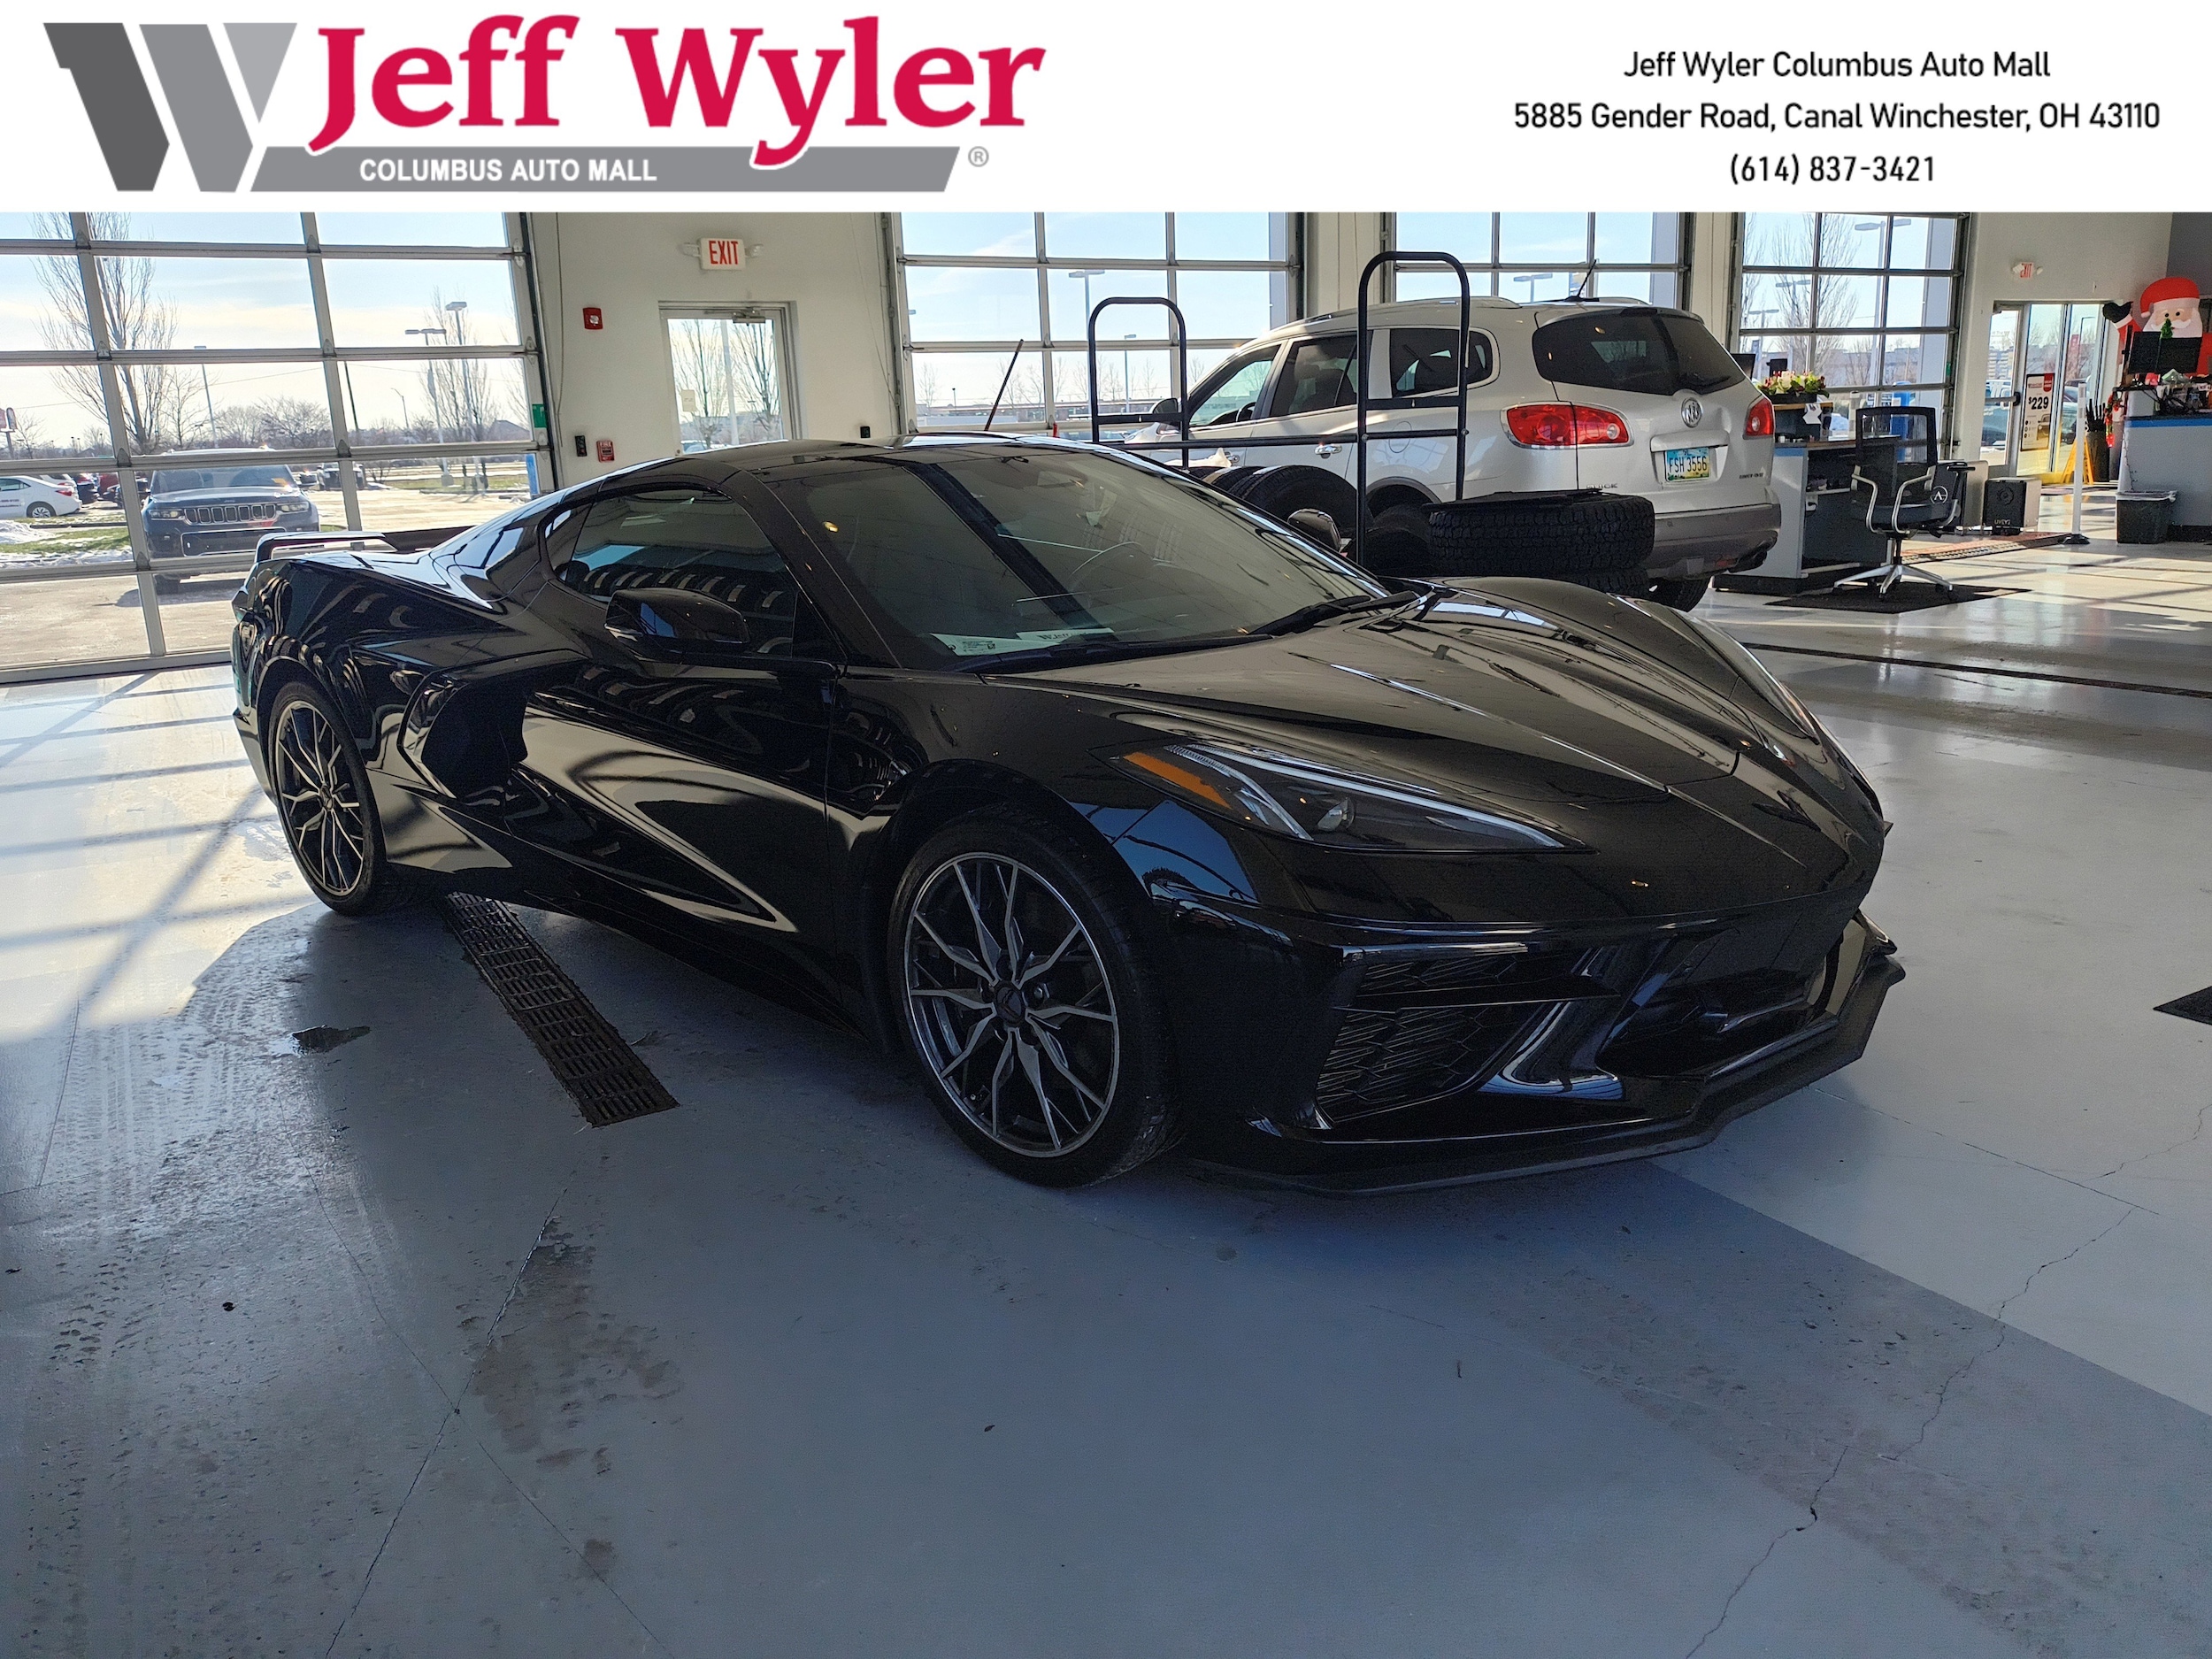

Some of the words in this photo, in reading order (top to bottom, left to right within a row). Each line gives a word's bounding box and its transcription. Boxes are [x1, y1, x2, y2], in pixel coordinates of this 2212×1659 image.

[709, 240, 739, 265] EXIT
[2028, 396, 2050, 410] $229
[1669, 457, 1685, 473] FSH
[1686, 456, 1708, 472] 3556
